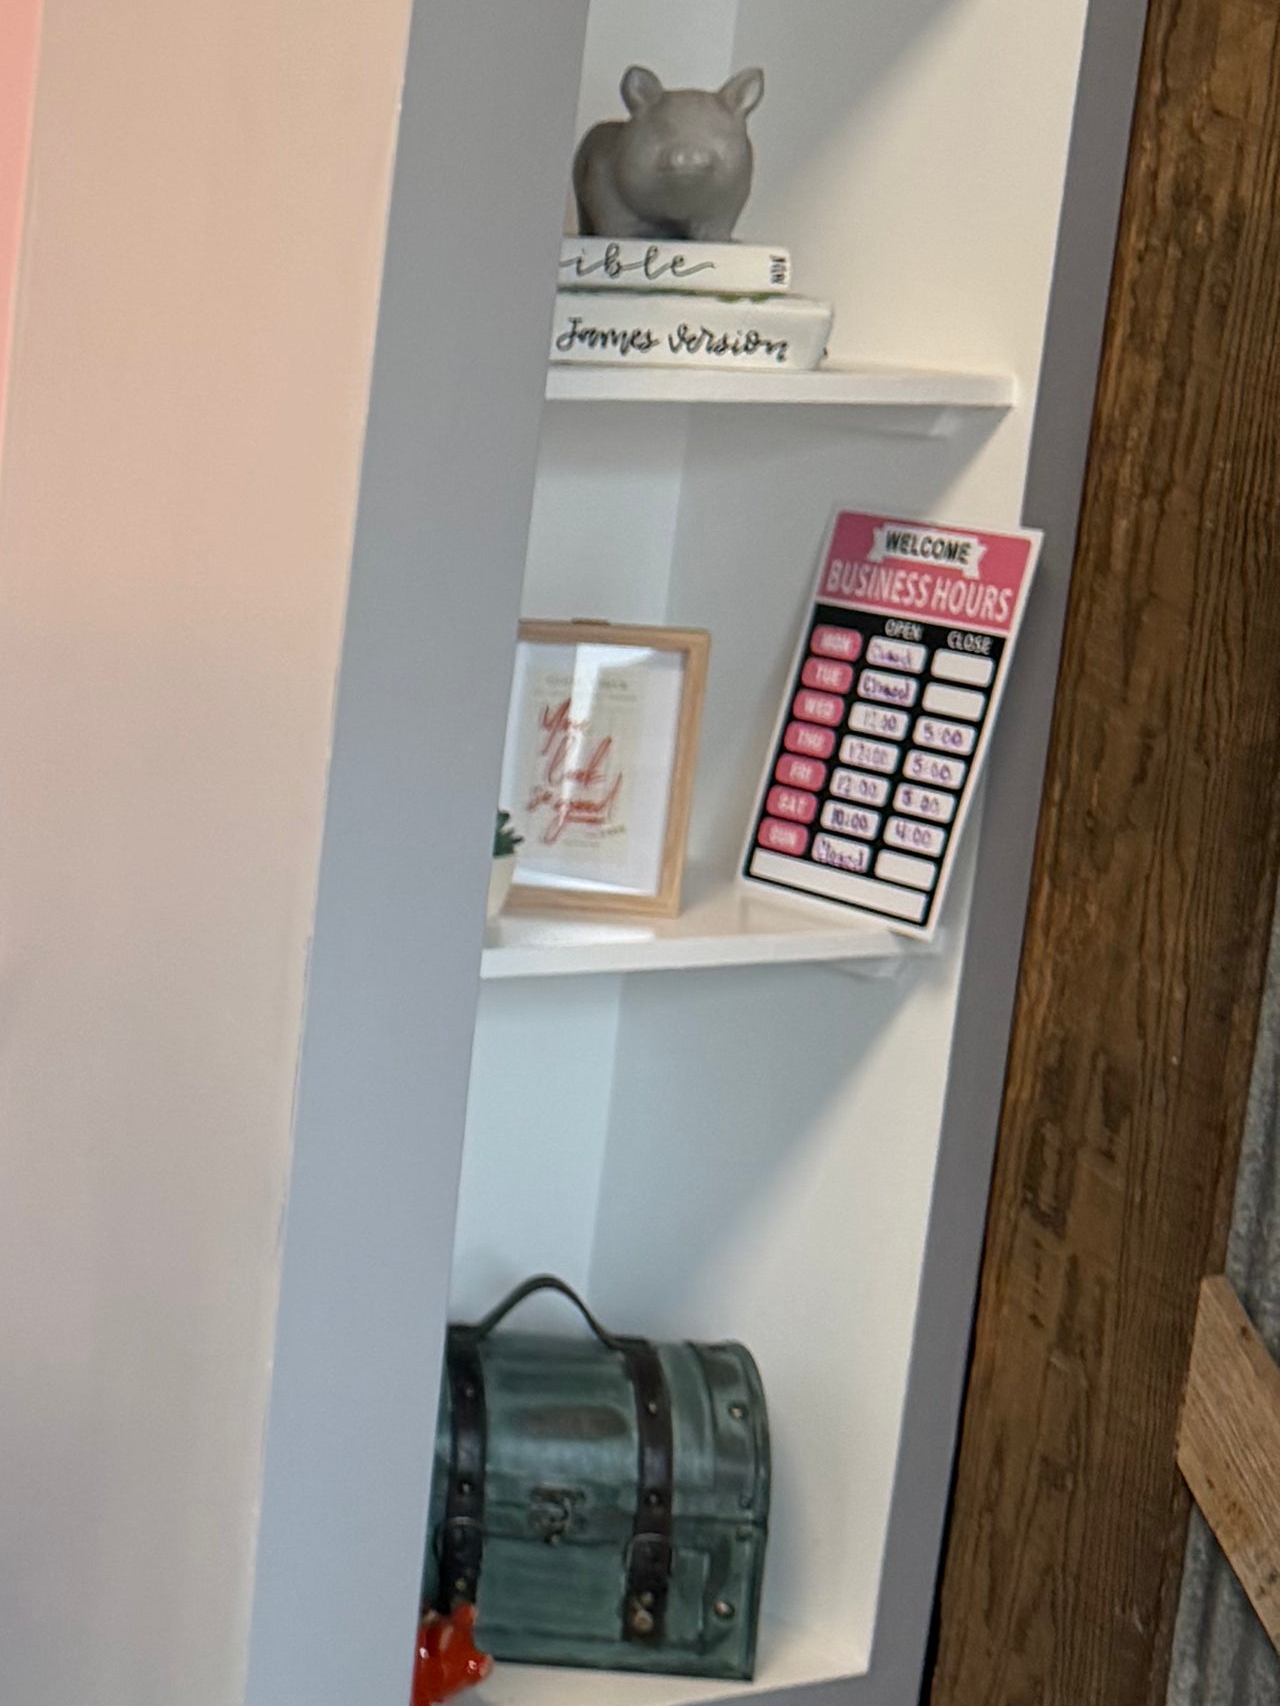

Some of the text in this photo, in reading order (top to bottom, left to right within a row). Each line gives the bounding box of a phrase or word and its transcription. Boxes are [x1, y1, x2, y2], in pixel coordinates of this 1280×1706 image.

[559, 243, 715, 280] ible
[556, 316, 658, 356] James
[886, 529, 971, 565] WELCOME
[826, 559, 1012, 623] BUSINESS HOURS
[884, 619, 993, 656] OPEN CLOSE
